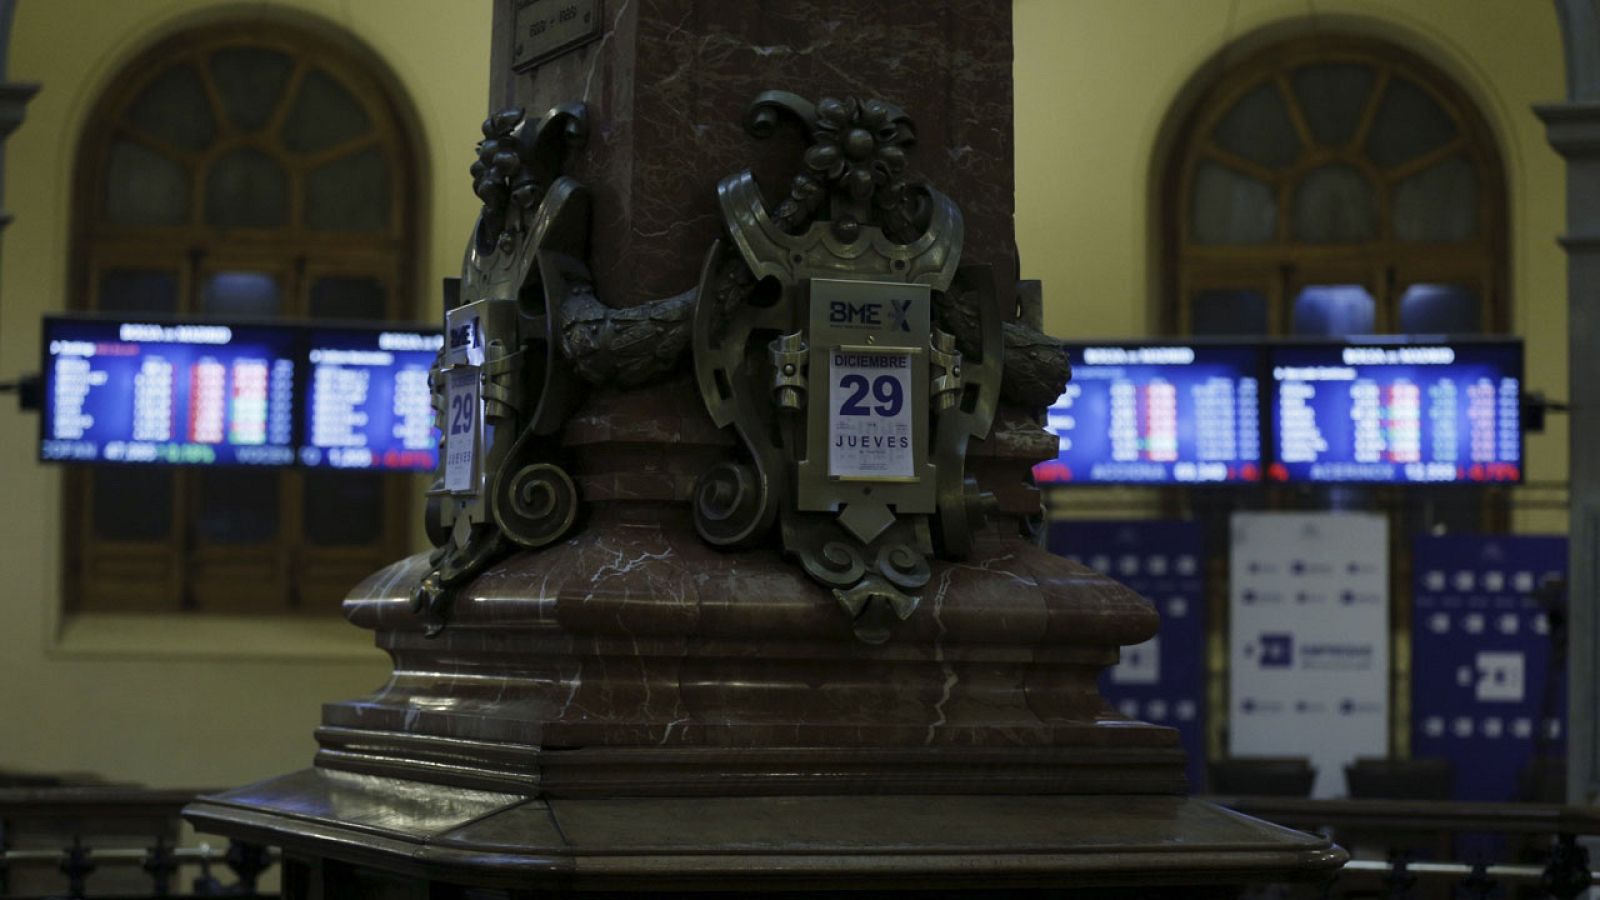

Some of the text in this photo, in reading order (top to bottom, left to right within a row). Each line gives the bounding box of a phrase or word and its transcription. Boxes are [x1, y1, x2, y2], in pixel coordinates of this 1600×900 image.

[829, 301, 882, 325] BME
[834, 354, 908, 369] DICIEMBRE
[839, 374, 904, 417] 29
[451, 392, 473, 436] 29
[835, 435, 909, 449] JUEVES
[448, 450, 471, 465] JUEVES
